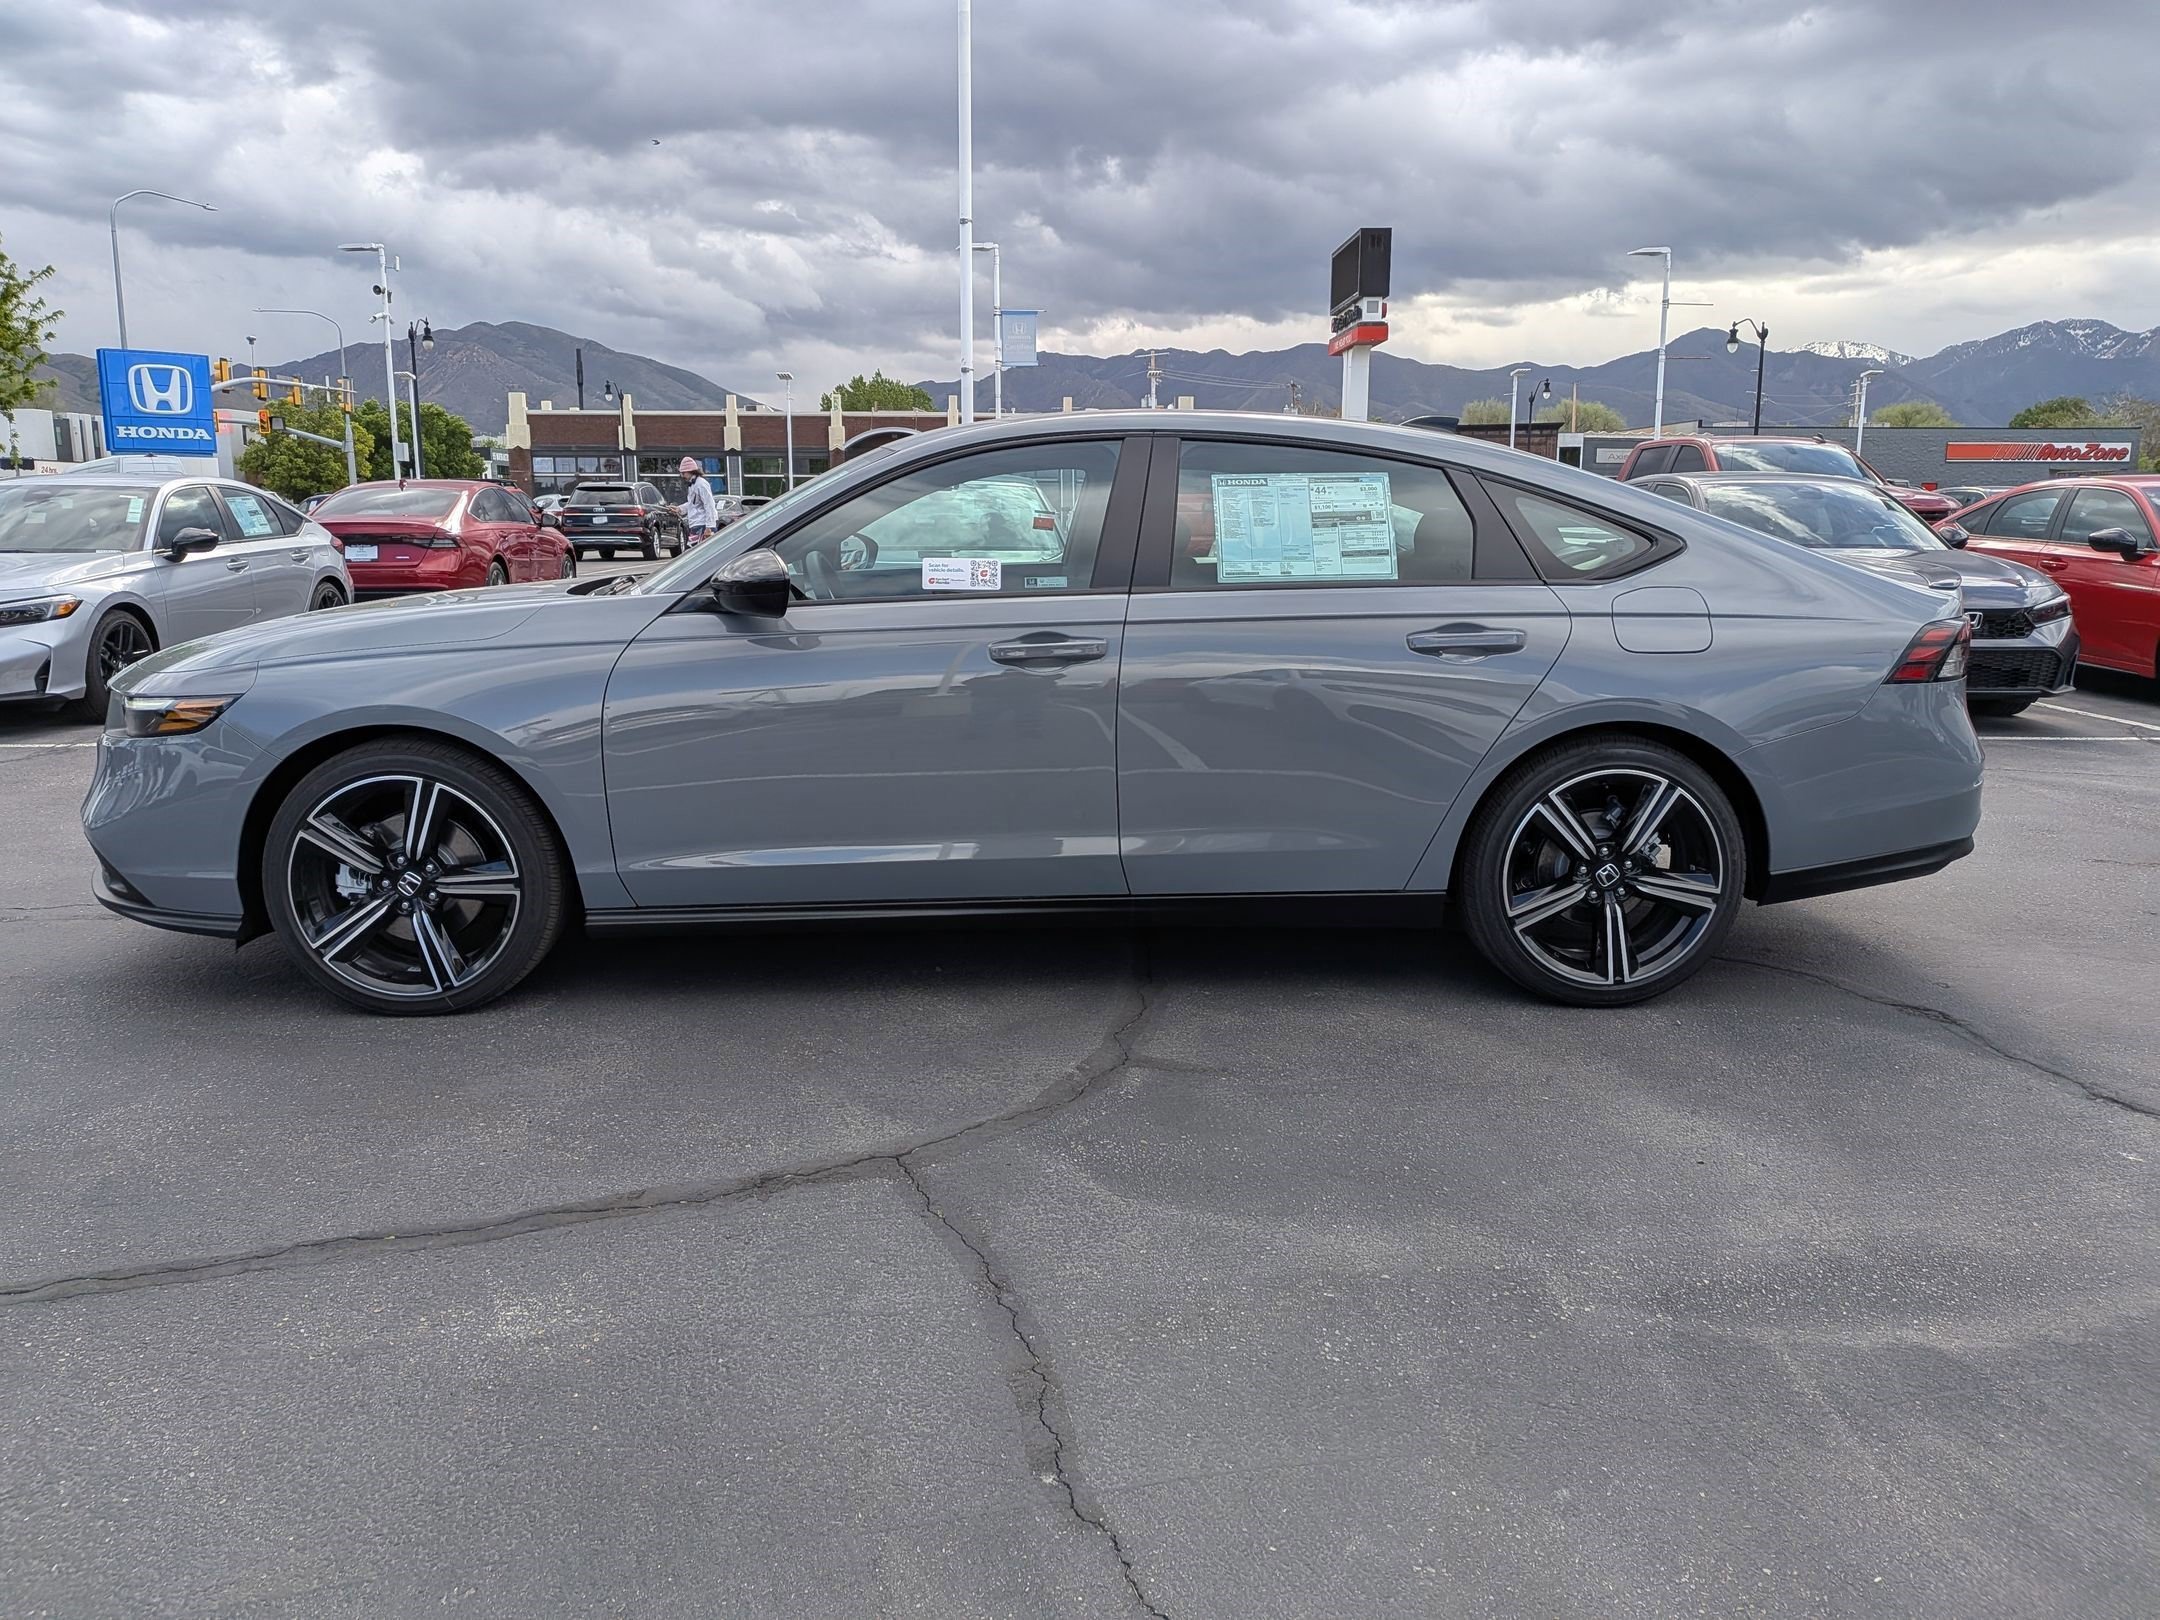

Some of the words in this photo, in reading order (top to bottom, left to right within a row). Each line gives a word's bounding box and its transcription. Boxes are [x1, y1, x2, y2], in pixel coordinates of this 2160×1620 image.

[116, 426, 212, 440] HONDA
[2035, 443, 2129, 460] AutoZone
[1314, 486, 1327, 494] 44
